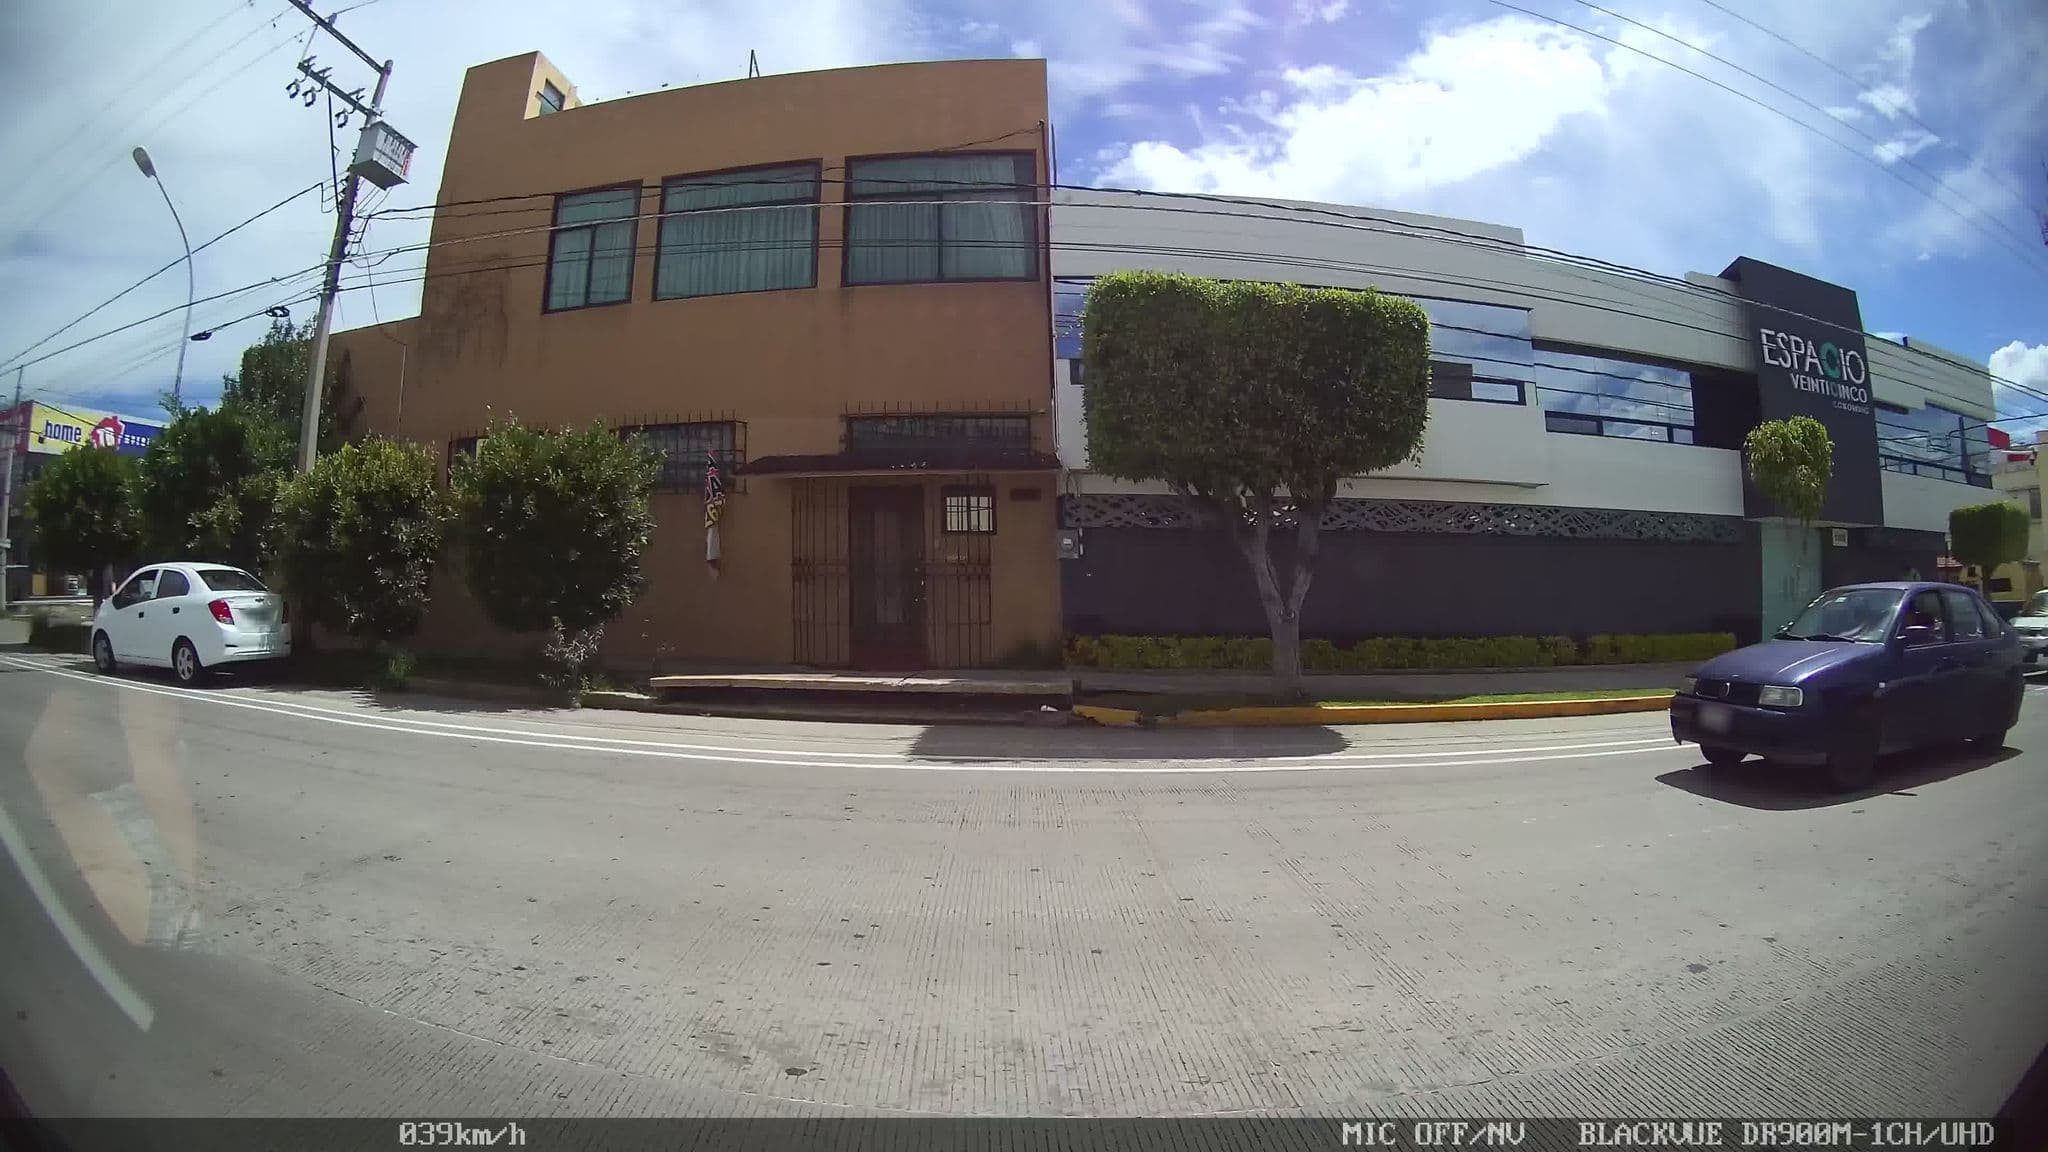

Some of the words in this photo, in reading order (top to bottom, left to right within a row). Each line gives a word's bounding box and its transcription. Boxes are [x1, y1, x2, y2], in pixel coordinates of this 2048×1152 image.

[1760, 328, 1866, 384] ESPACIO
[1790, 372, 1867, 403] VEINTICINCO
[44, 420, 82, 443] home
